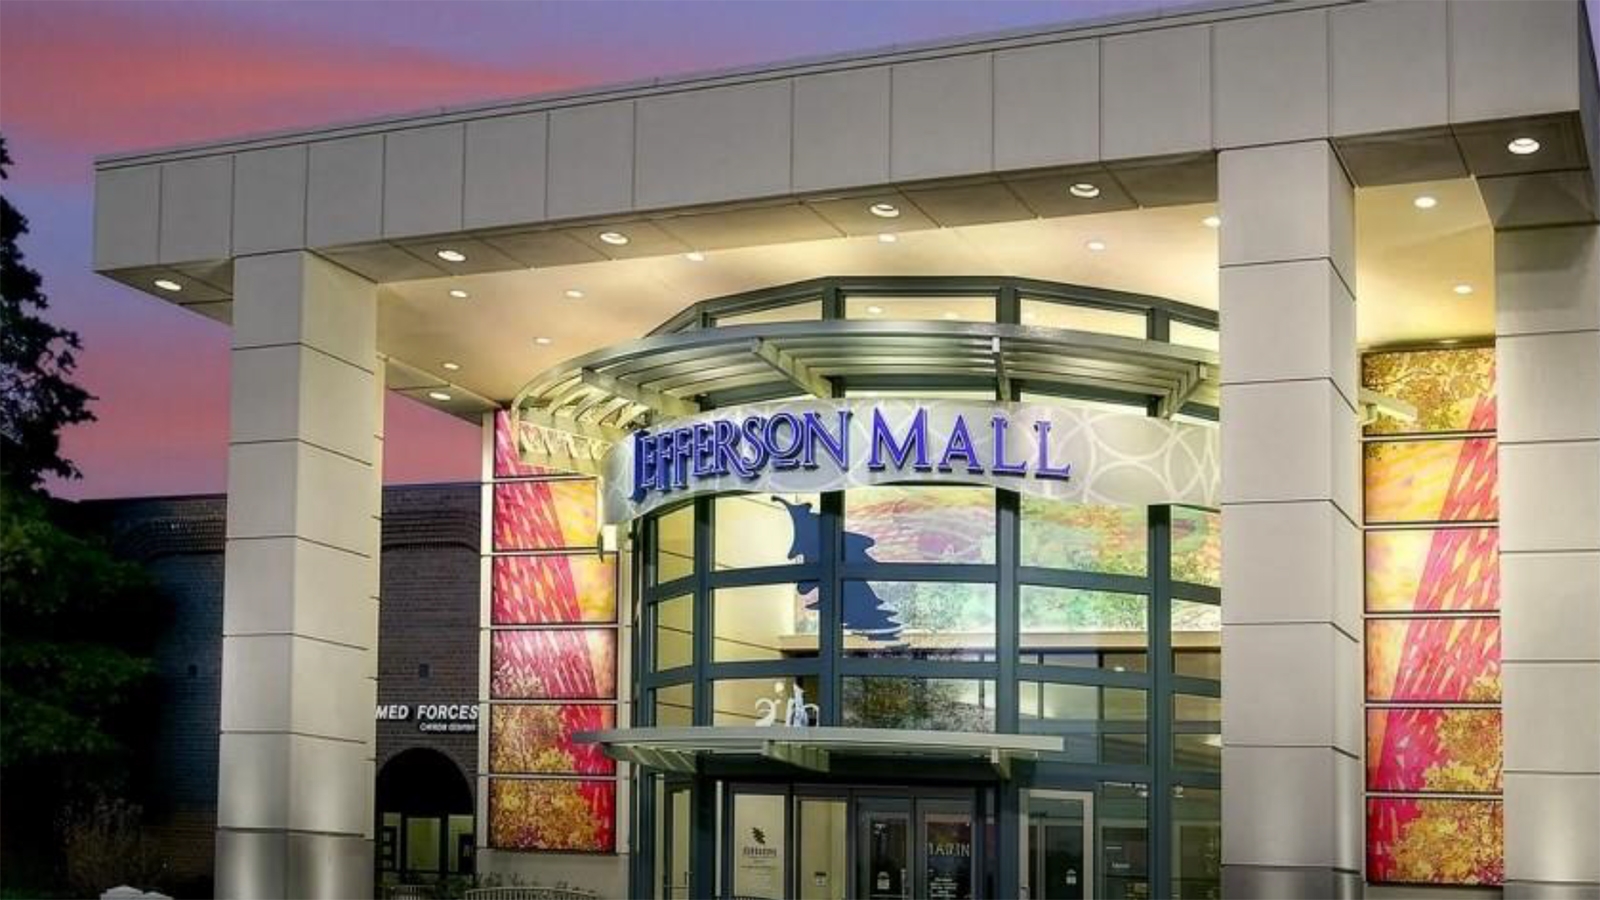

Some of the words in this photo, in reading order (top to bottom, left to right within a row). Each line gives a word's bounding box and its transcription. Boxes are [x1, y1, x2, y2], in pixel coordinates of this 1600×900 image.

[630, 410, 853, 503] JEFFERSON
[868, 407, 1071, 481] MALL
[417, 704, 479, 719] FORCES
